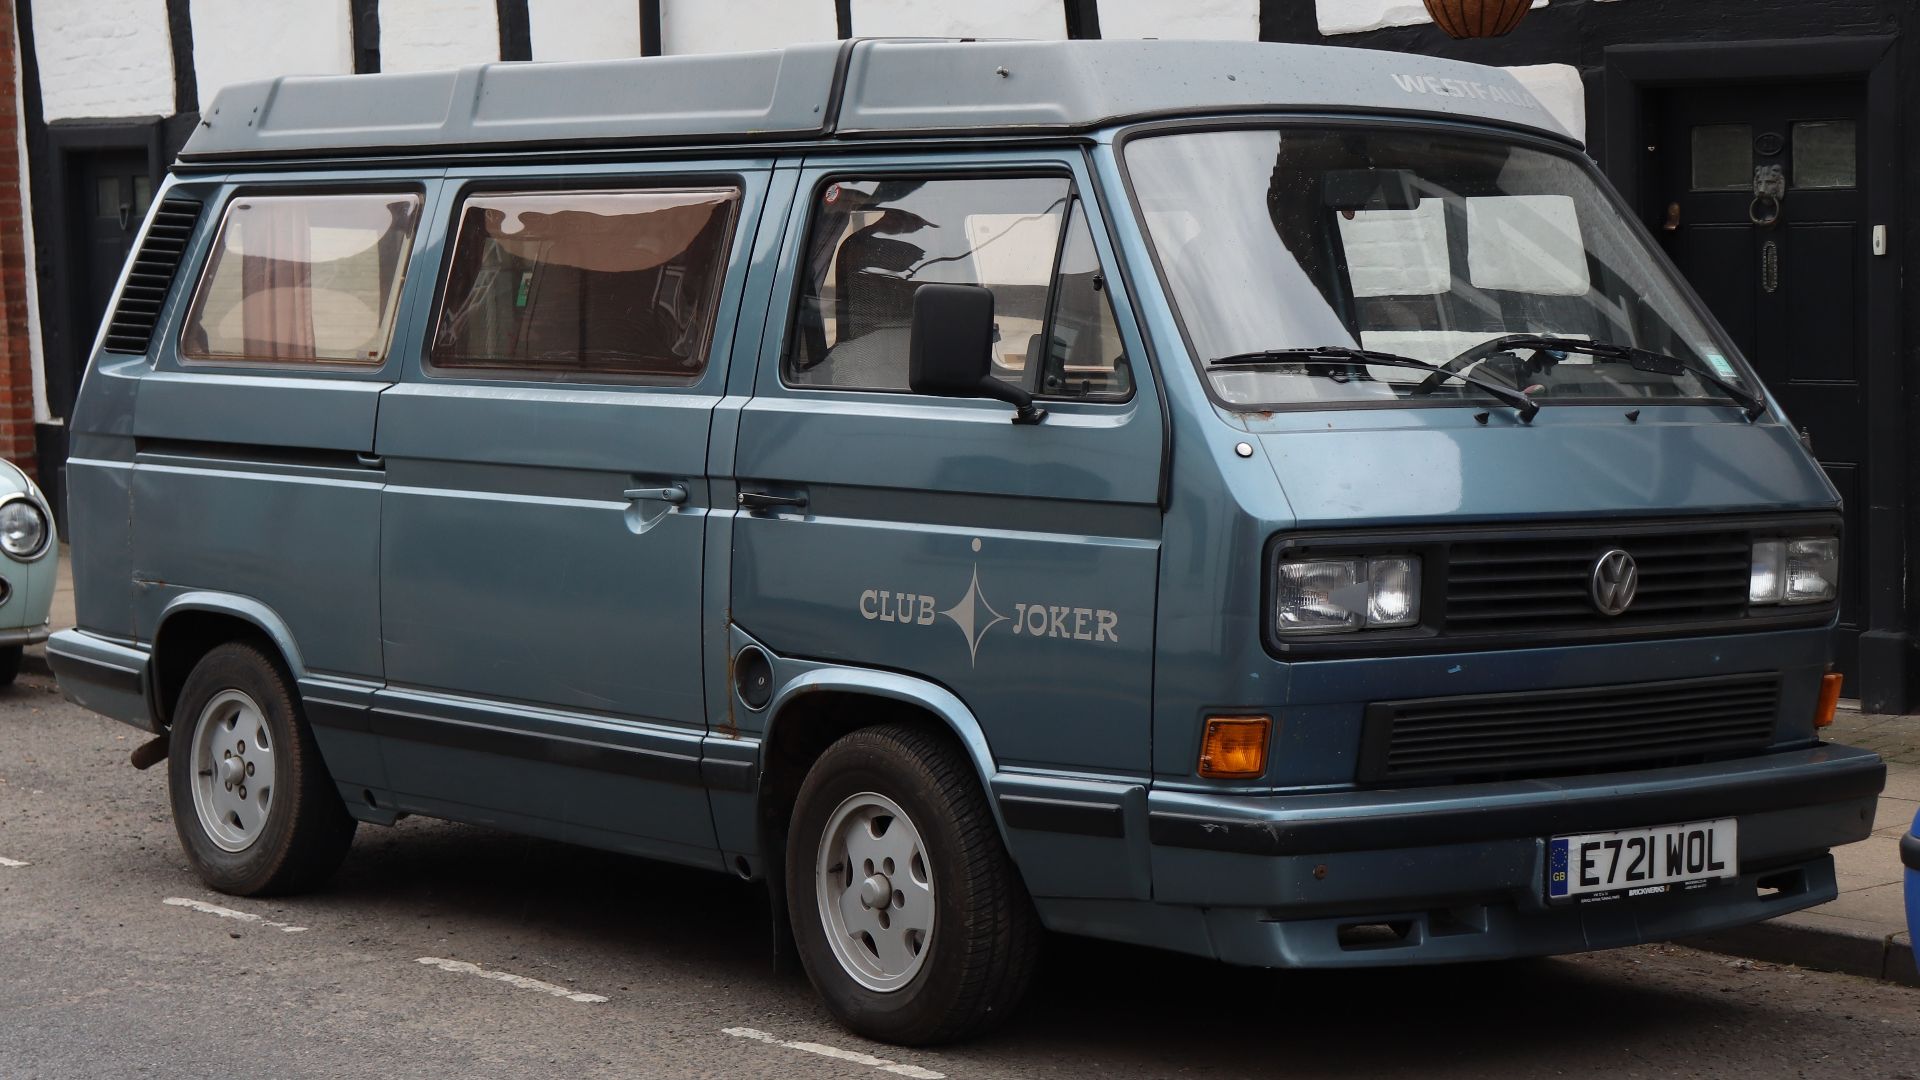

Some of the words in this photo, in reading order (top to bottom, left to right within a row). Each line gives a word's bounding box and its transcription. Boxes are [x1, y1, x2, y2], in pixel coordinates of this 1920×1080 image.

[859, 589, 936, 626] CLUB
[1012, 603, 1118, 643] JOKER
[1552, 871, 1566, 882] GB
[1579, 836, 1656, 887] E721
[1666, 828, 1725, 877] WOL
